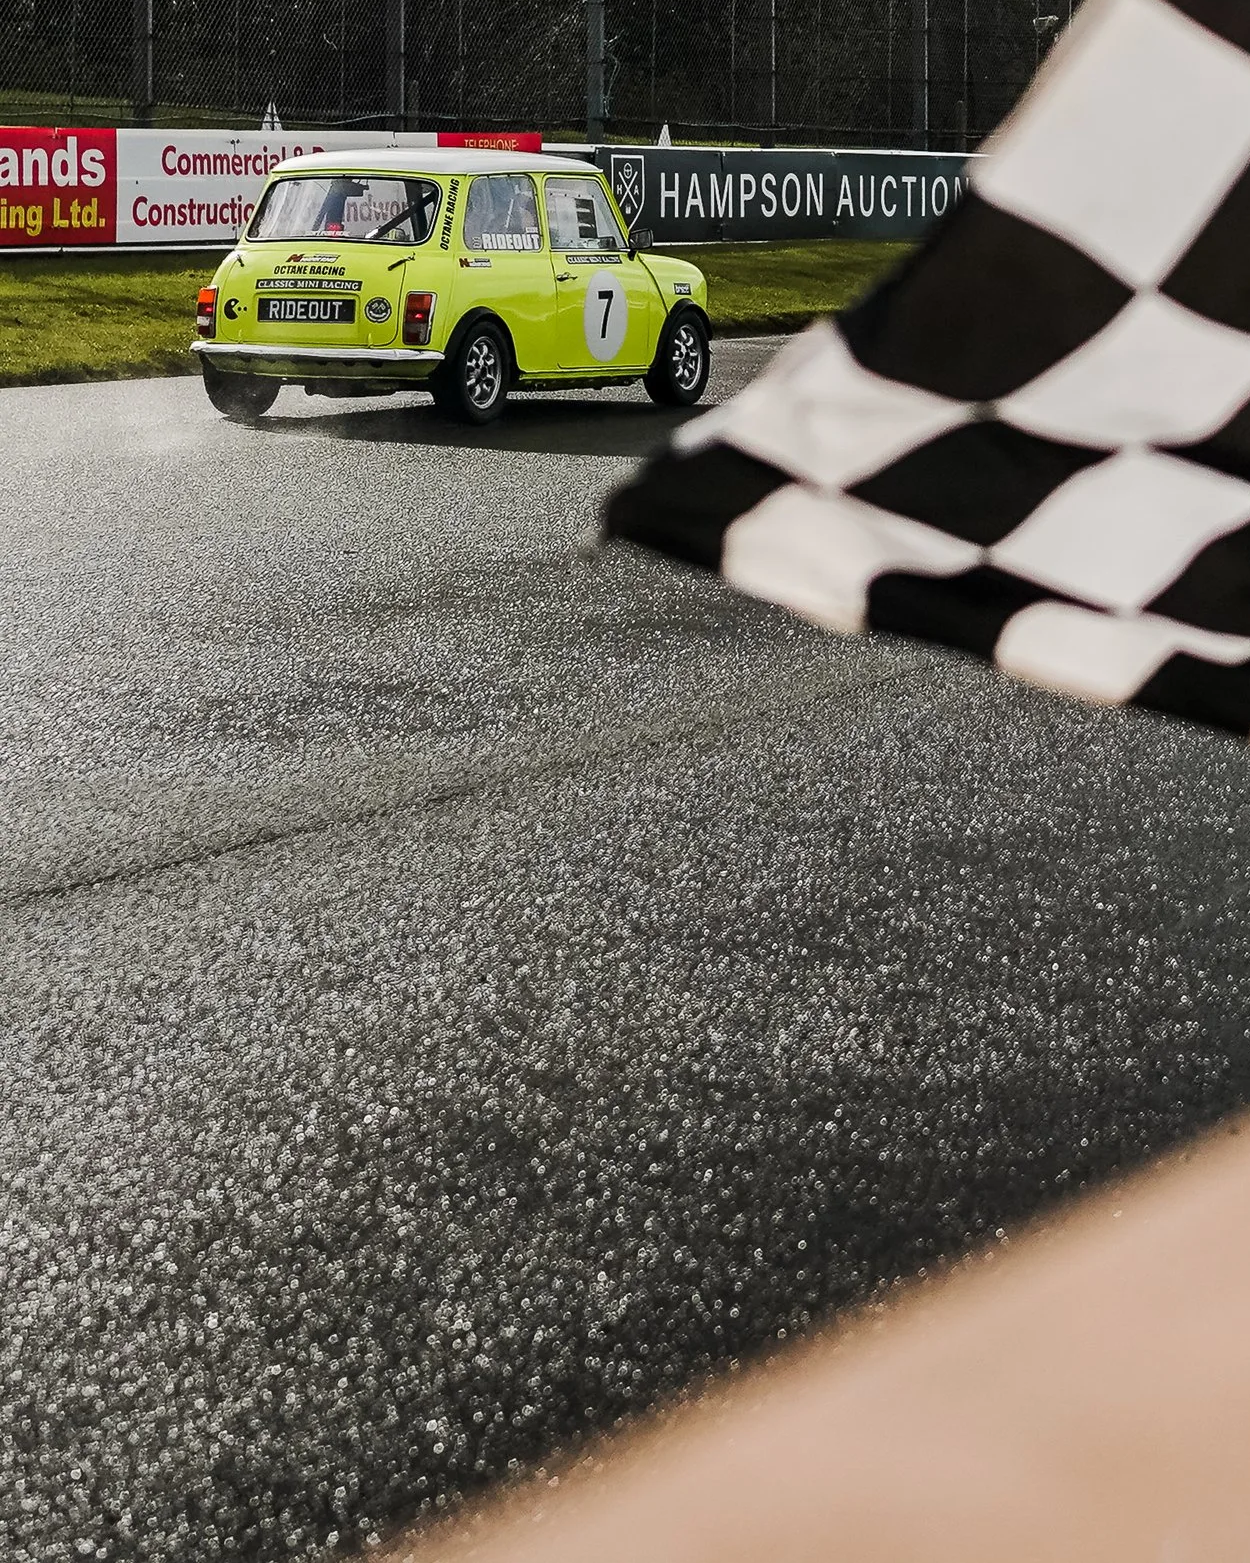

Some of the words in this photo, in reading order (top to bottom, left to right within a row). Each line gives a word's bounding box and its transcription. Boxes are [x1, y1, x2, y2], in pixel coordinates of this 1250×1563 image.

[161, 145, 286, 176] Commercial
[446, 178, 460, 214] RACING
[660, 172, 824, 219] HAMPSON
[53, 197, 106, 228] Ltd.
[440, 214, 455, 251] OCTANE
[481, 233, 540, 250] RIDEOUT
[257, 280, 295, 288] CLASSIC
[296, 280, 319, 288] MINI
[321, 281, 359, 290] RACING
[273, 265, 308, 275] OCTANE
[309, 266, 346, 276] RACING
[269, 300, 343, 320] RIDEOUT
[598, 290, 614, 339] 7
